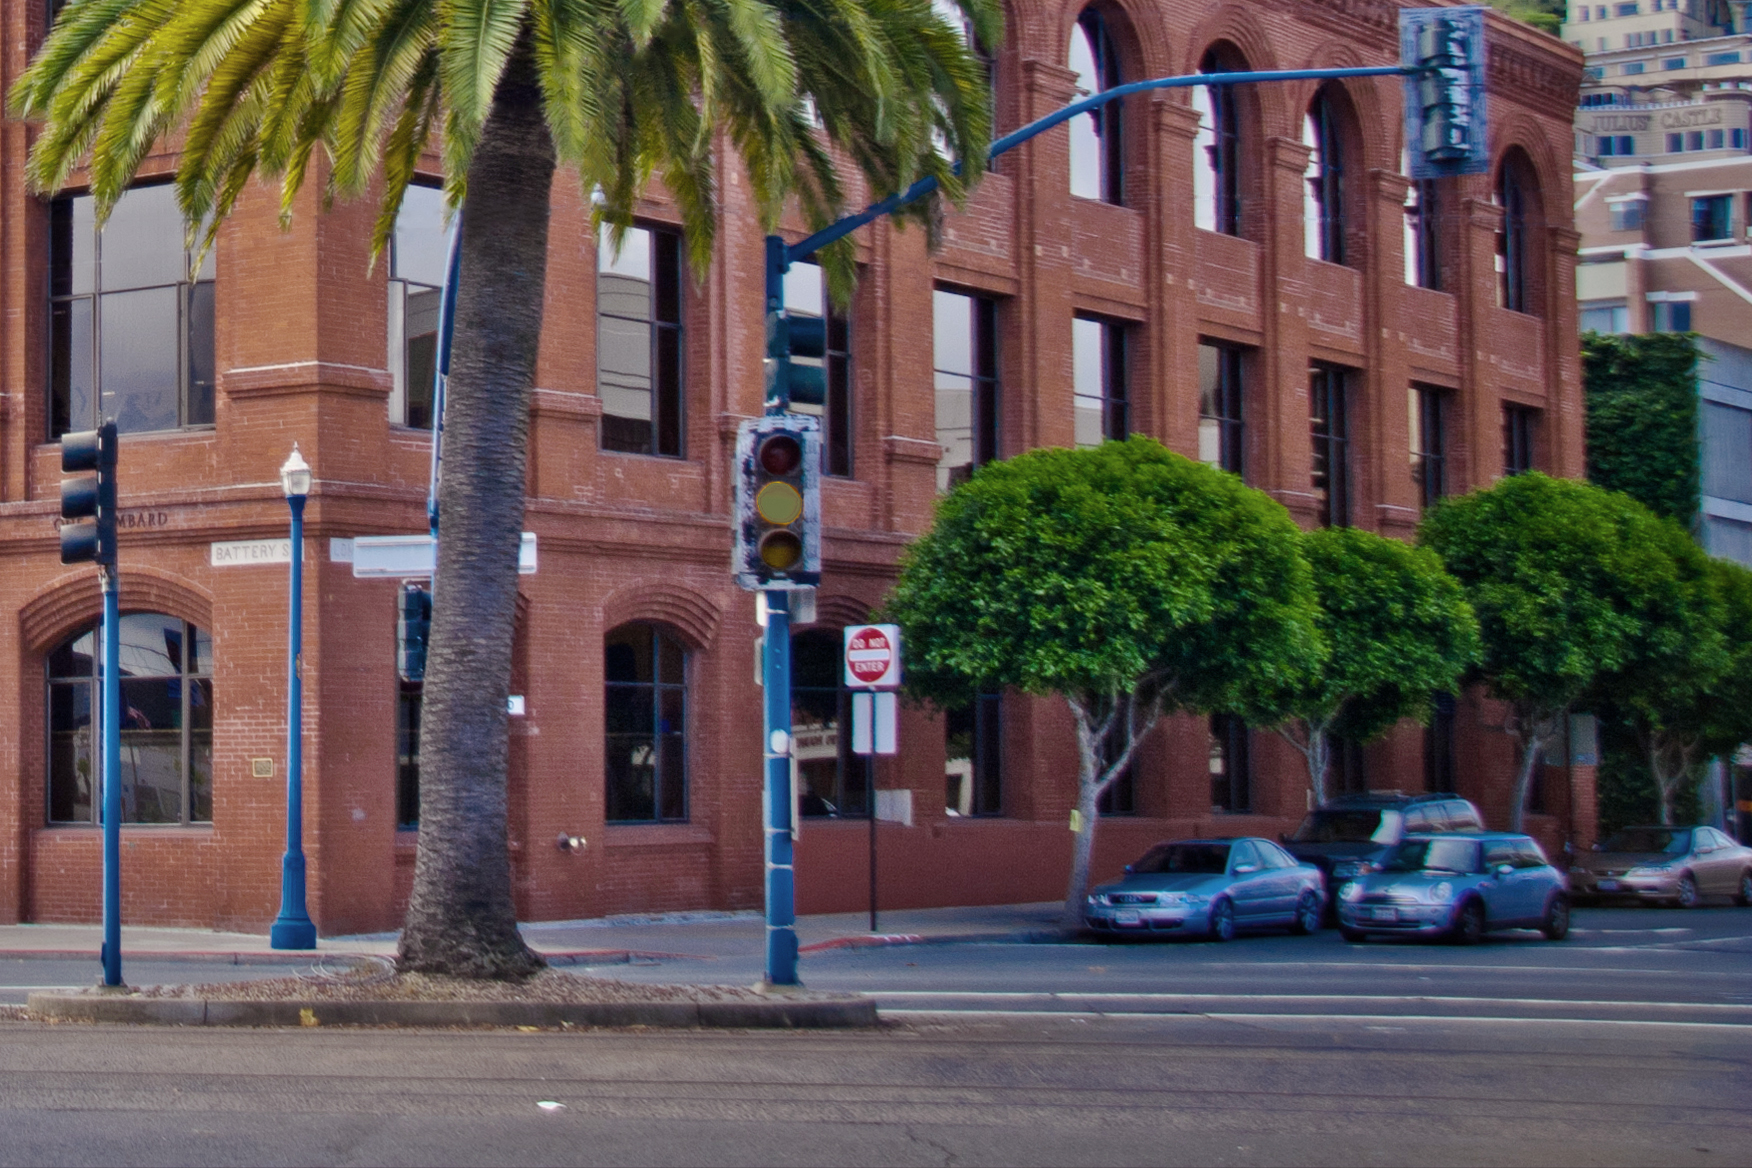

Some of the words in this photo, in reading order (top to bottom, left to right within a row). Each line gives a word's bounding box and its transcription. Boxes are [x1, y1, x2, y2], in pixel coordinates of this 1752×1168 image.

[1660, 108, 1721, 129] CASTLE
[115, 512, 168, 529] MBARD
[216, 544, 277, 561] BATTERY
[852, 638, 866, 649] DO
[868, 637, 886, 648] NOT
[855, 661, 885, 673] ENTER
